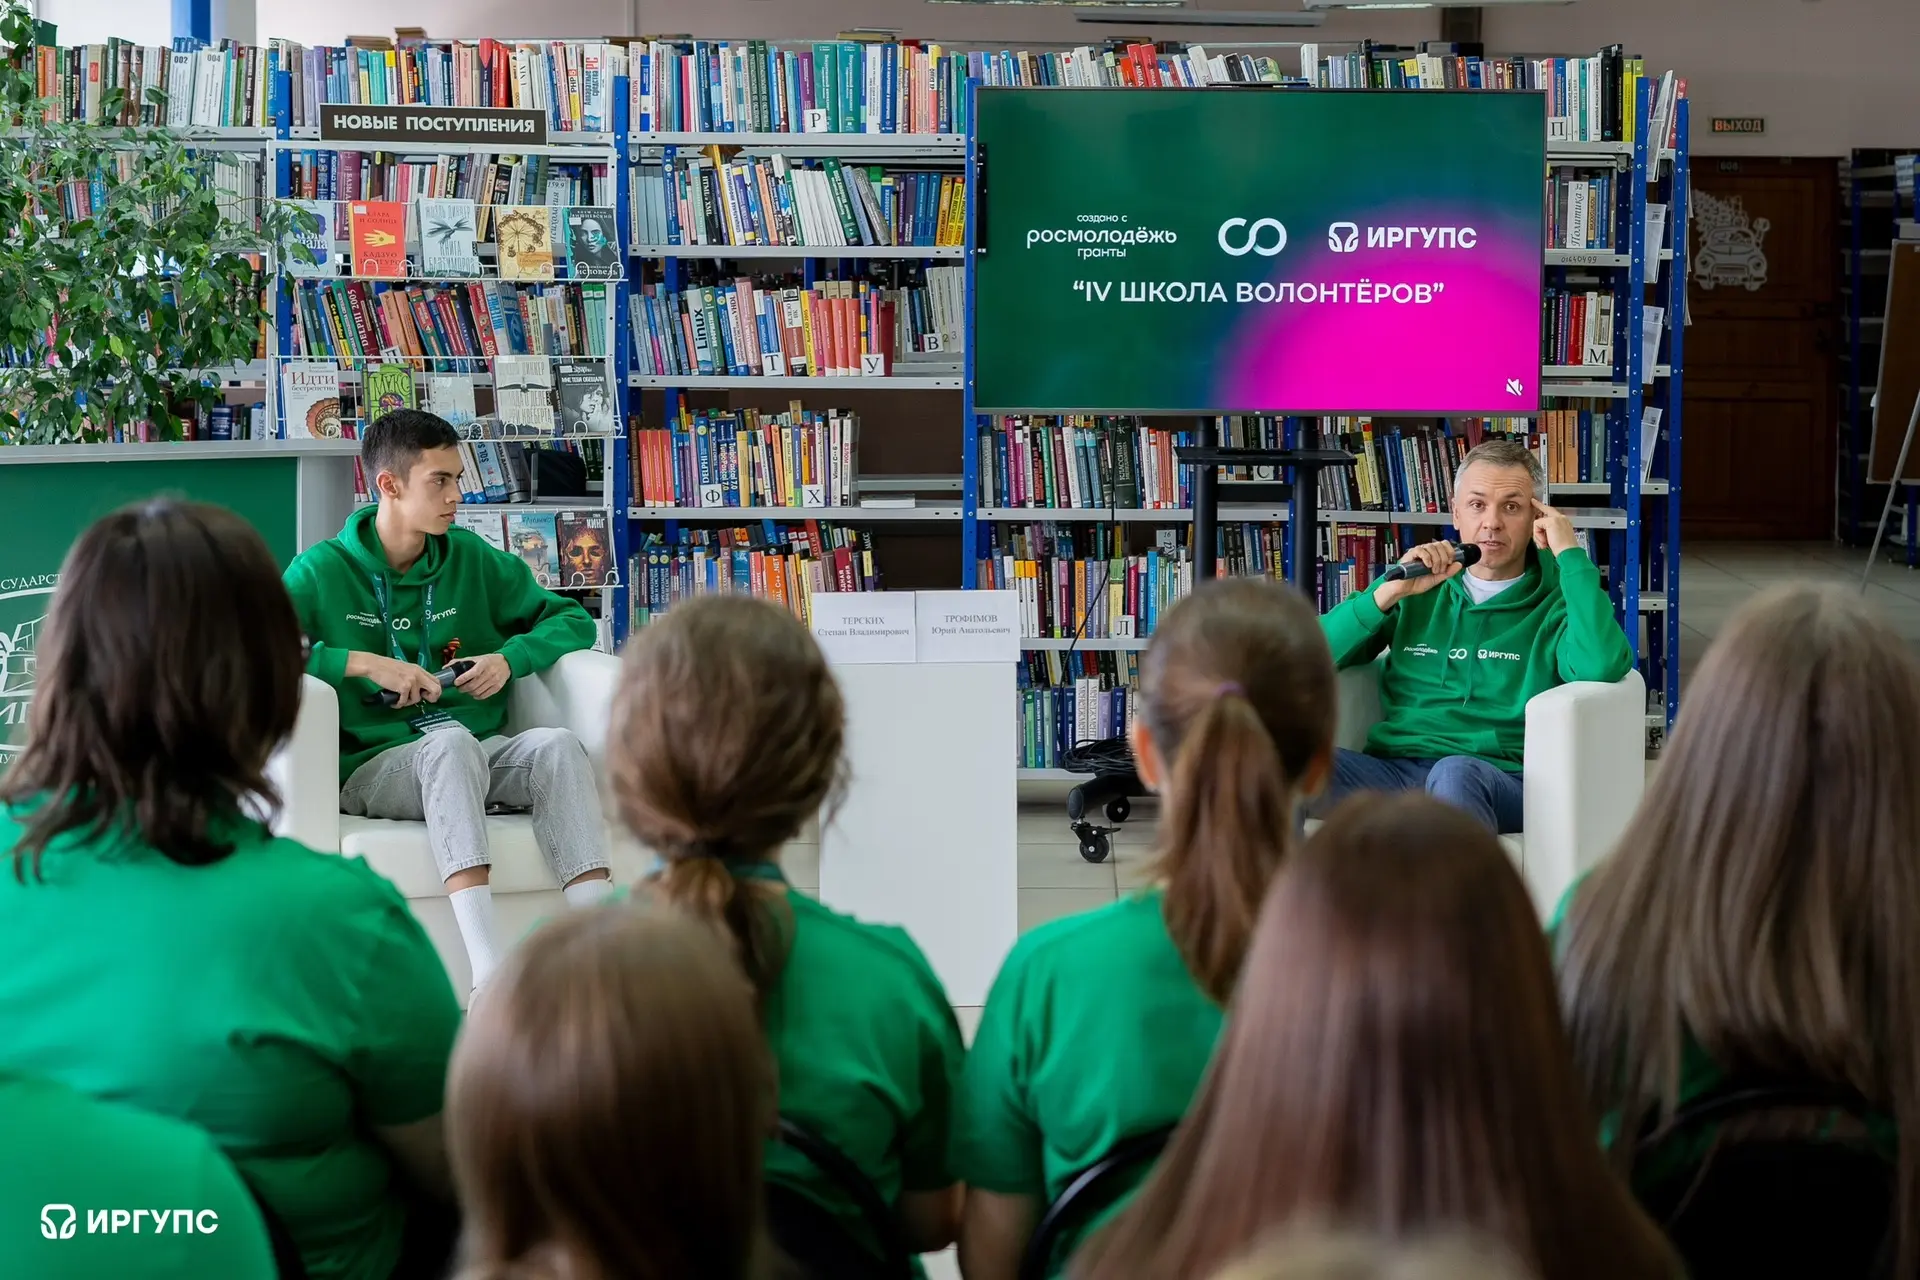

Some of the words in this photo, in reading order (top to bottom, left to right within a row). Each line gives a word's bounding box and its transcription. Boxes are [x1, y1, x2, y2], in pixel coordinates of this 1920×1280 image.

[173, 55, 188, 65] 002
[206, 54, 221, 63] 004
[519, 64, 527, 87] UNIX
[570, 77, 578, 94] PHP
[584, 70, 592, 106] Аппаратные
[591, 70, 599, 98] средства
[333, 114, 398, 130] НОВЫЕ
[405, 116, 536, 134] ПОСТУПЛЕНИЯ
[1552, 122, 1564, 136] П
[1714, 118, 1763, 132] ВЫХОД
[702, 175, 711, 199] HTML
[704, 201, 712, 217] XML
[1076, 213, 1118, 224] создано
[1121, 214, 1128, 223] с
[1571, 192, 1585, 247] Политика
[1026, 226, 1177, 249] росмолодёжь
[1366, 226, 1477, 249] ИРГУПС
[1077, 246, 1127, 260] гранты
[1120, 281, 1228, 303] ШКОЛА
[1235, 278, 1444, 304] ВОЛОНТЁРОВ”
[347, 289, 359, 310] 2005
[486, 292, 505, 330] ИНТЕРНЕТ
[356, 312, 369, 347] DELPHI
[694, 308, 709, 350] Linux
[951, 330, 958, 340] 3
[942, 333, 949, 343] 2
[484, 340, 496, 356] 005
[765, 354, 779, 371] Т
[291, 372, 335, 386] Идти
[1116, 441, 1126, 481] КЛАССИКИ
[701, 455, 710, 484] DELPHI
[705, 489, 721, 502] Ф
[807, 490, 821, 504] Х
[586, 517, 605, 530] КИНГ
[772, 557, 780, 574] .NET
[845, 565, 853, 593] ГРАФИЯ
[346, 613, 386, 626] росмолод
[431, 607, 457, 622] РГУПС
[842, 616, 885, 625] ТЕРСКИХ
[943, 613, 998, 623] ТРОФИМОВ
[817, 627, 848, 637] Степан
[848, 627, 910, 637] Владимирович
[931, 626, 957, 635] Юрий
[958, 625, 1011, 635] Анатольевич
[1116, 619, 1130, 637] Л
[1488, 650, 1521, 661] ИРГУПС
